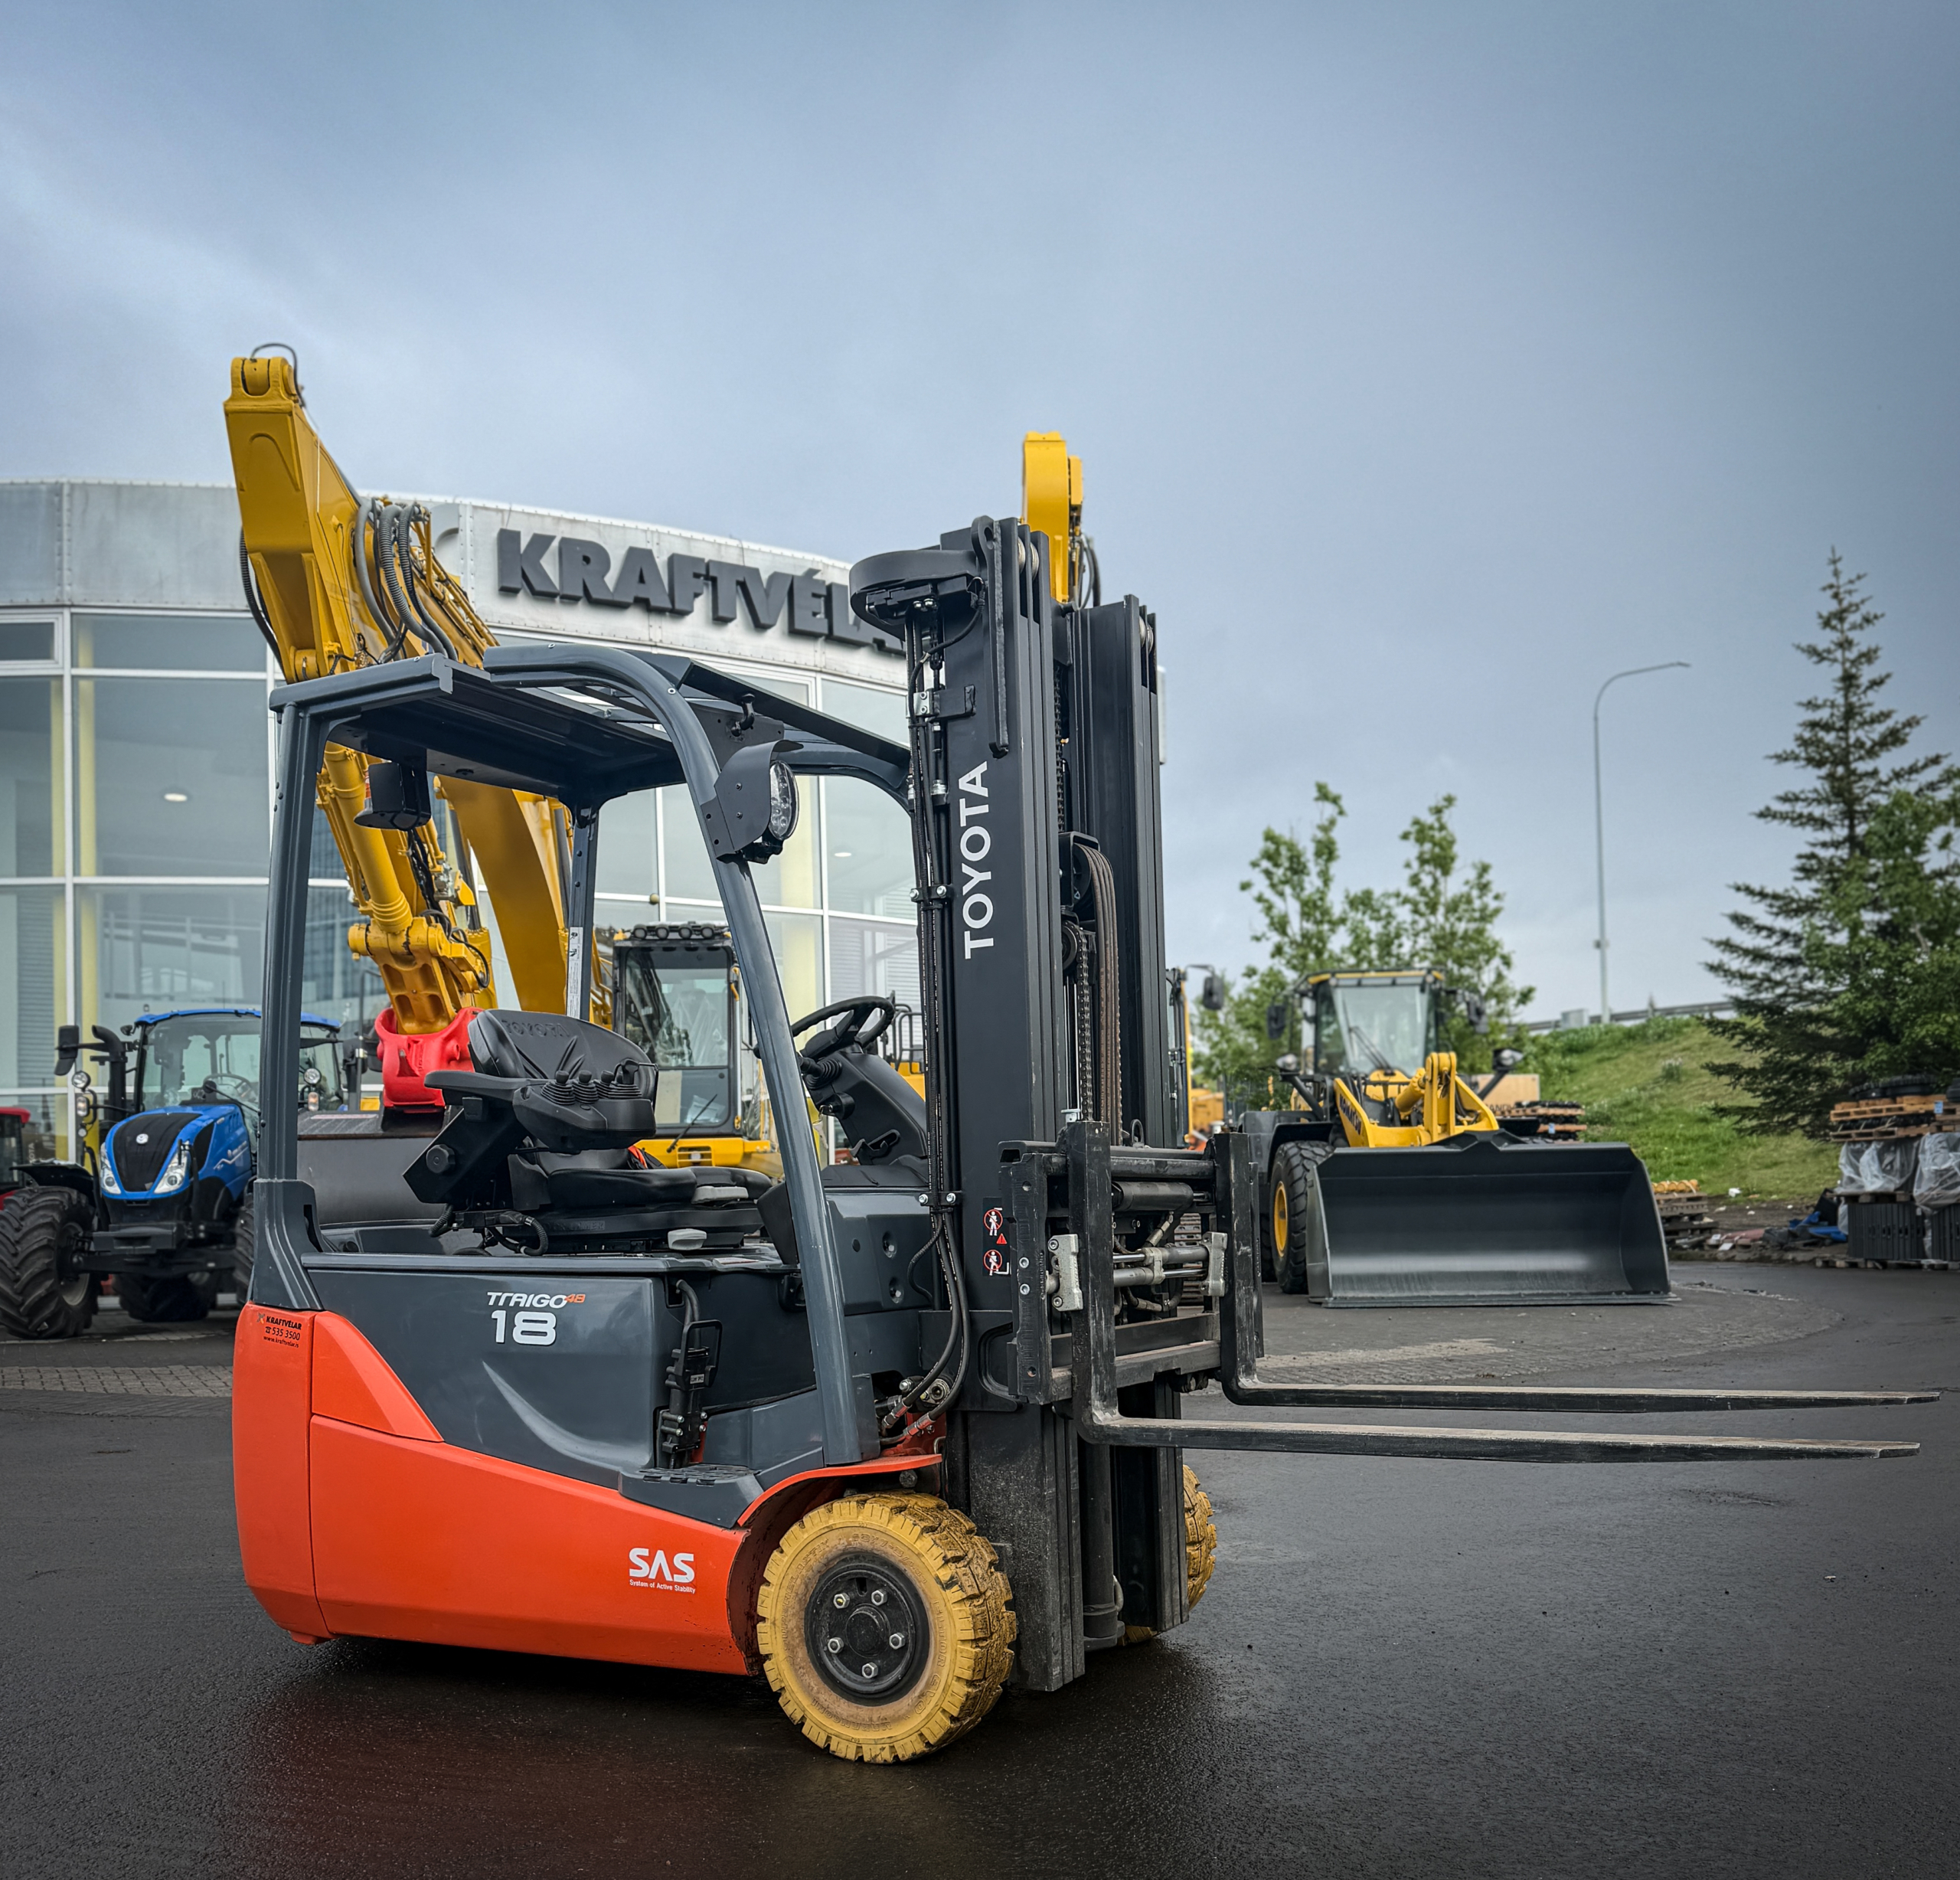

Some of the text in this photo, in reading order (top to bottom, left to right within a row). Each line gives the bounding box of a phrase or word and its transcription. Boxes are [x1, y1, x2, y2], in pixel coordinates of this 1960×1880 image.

[959, 761, 994, 960] TOYOTA
[487, 1291, 567, 1309] TRAIGO
[272, 1327, 301, 1341] 535 3500
[491, 1309, 557, 1345] 18
[629, 1547, 695, 1583] SAS
[629, 1579, 648, 1587] System
[674, 1584, 696, 1594] Stability
